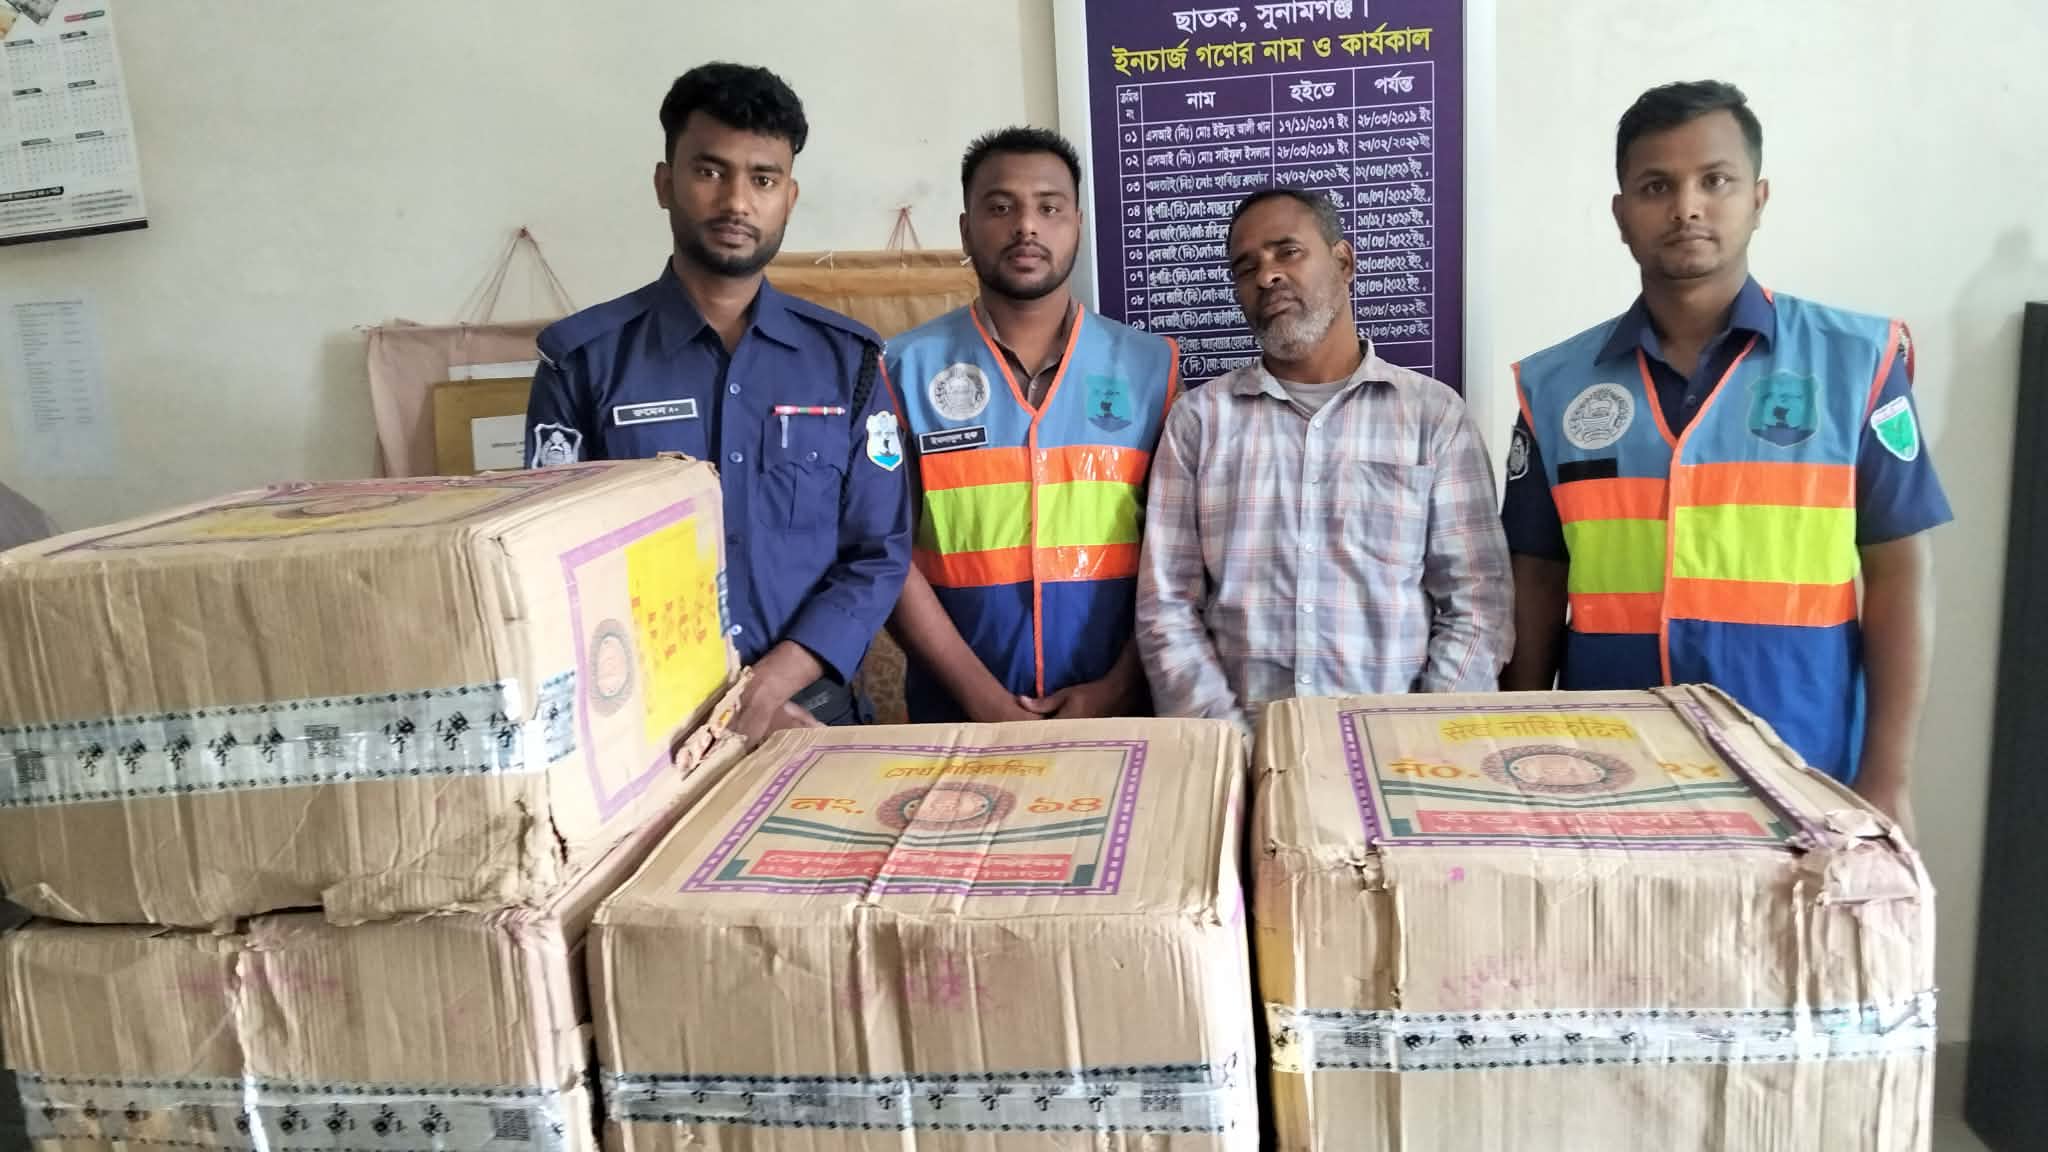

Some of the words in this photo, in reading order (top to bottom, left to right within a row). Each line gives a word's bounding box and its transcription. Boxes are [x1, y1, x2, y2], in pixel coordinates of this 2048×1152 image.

[1173, 7, 1248, 33] ছাতক,
[1111, 38, 1189, 76] ইনচার্জ
[1196, 41, 1256, 68] গণের
[1261, 37, 1305, 63] নাম
[1312, 37, 1331, 58] ও
[1339, 22, 1433, 57] কার্যকাল
[1289, 80, 1336, 103] হইতে
[1374, 70, 1415, 95] পর্যন্ত
[1185, 91, 1216, 110] নাম
[1279, 115, 1335, 135] ১৭/১১/২০১৭
[1125, 131, 1137, 143] ০১
[1125, 155, 1139, 167] ০২
[1128, 205, 1140, 217] ০৪
[1130, 271, 1143, 282] ০৭
